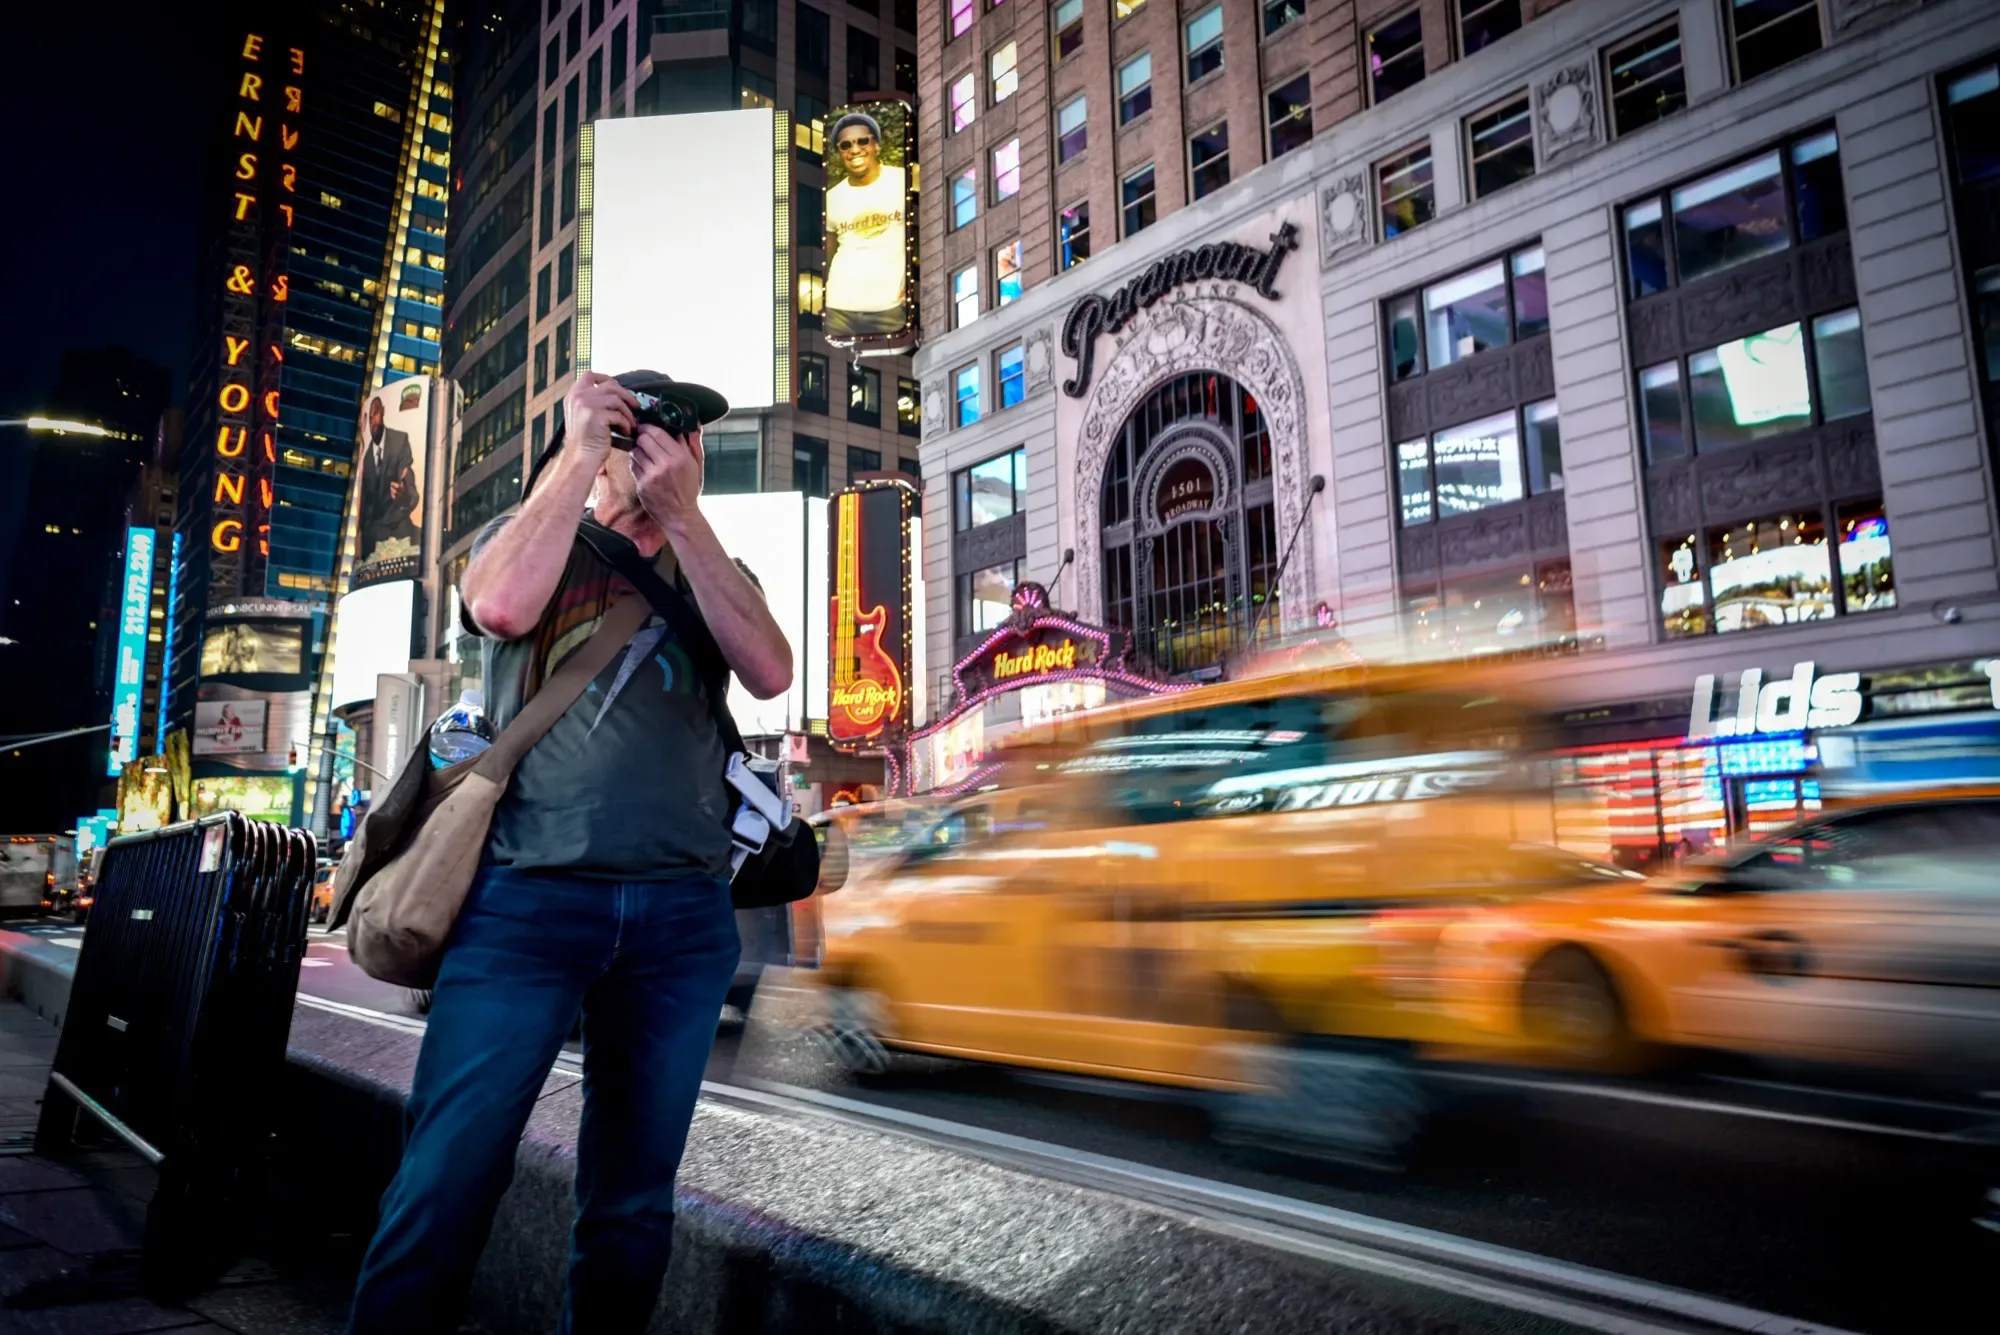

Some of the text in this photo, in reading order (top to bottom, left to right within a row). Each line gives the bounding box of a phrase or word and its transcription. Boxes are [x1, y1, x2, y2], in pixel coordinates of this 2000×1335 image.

[840, 209, 902, 233] Hard Rock
[211, 33, 264, 552] ERNST & YOUNG
[1061, 219, 1299, 398] Paramount
[1171, 478, 1201, 499] 1501
[1164, 499, 1210, 521] BROADWAY
[994, 638, 1075, 679] Hard Rock
[832, 685, 896, 706] Hard Rock
[1688, 661, 1862, 740] Lids
